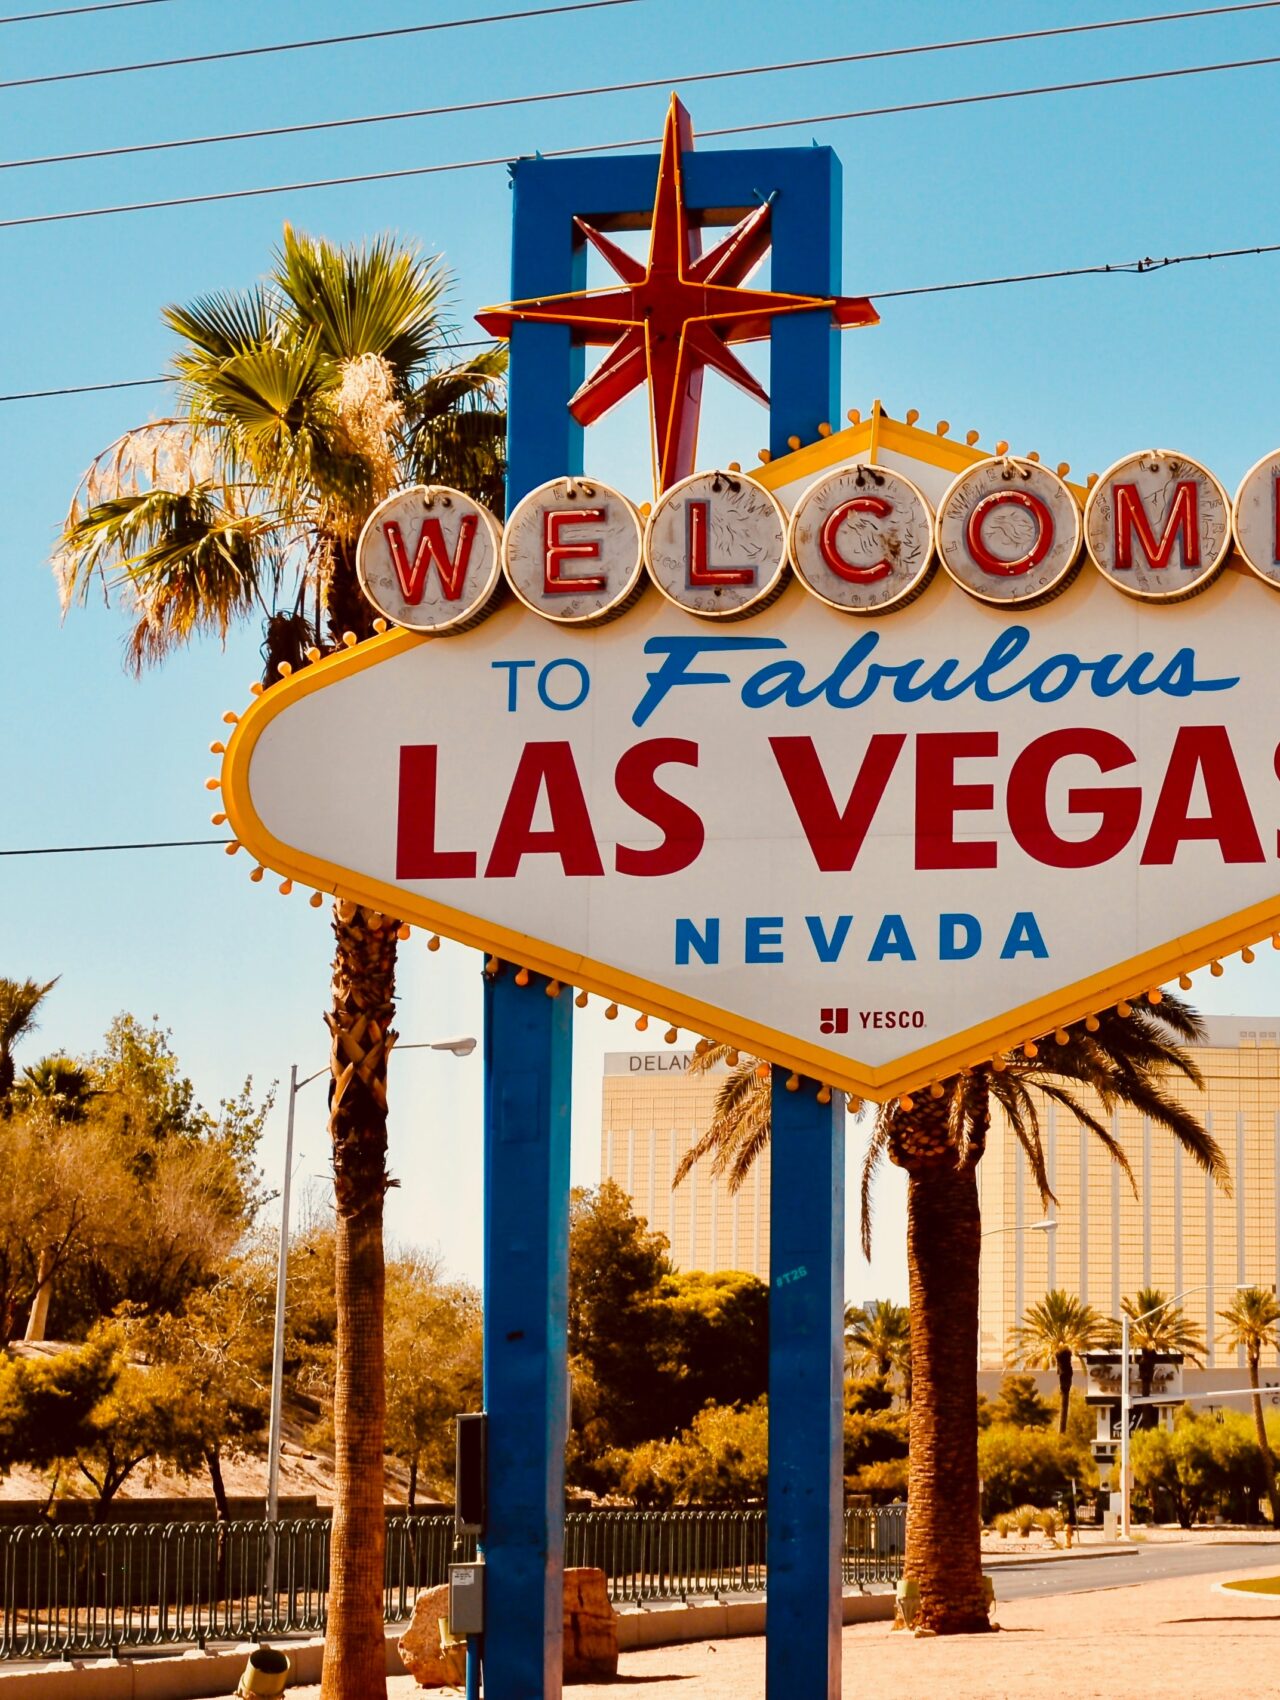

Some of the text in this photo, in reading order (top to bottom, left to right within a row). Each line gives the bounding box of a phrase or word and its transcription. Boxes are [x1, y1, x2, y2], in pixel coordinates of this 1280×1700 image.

[491, 625, 1240, 727] TO Fabulous
[395, 737, 705, 880] LAS
[675, 911, 1050, 966] NEVADA
[858, 1010, 926, 1029] YESCO
